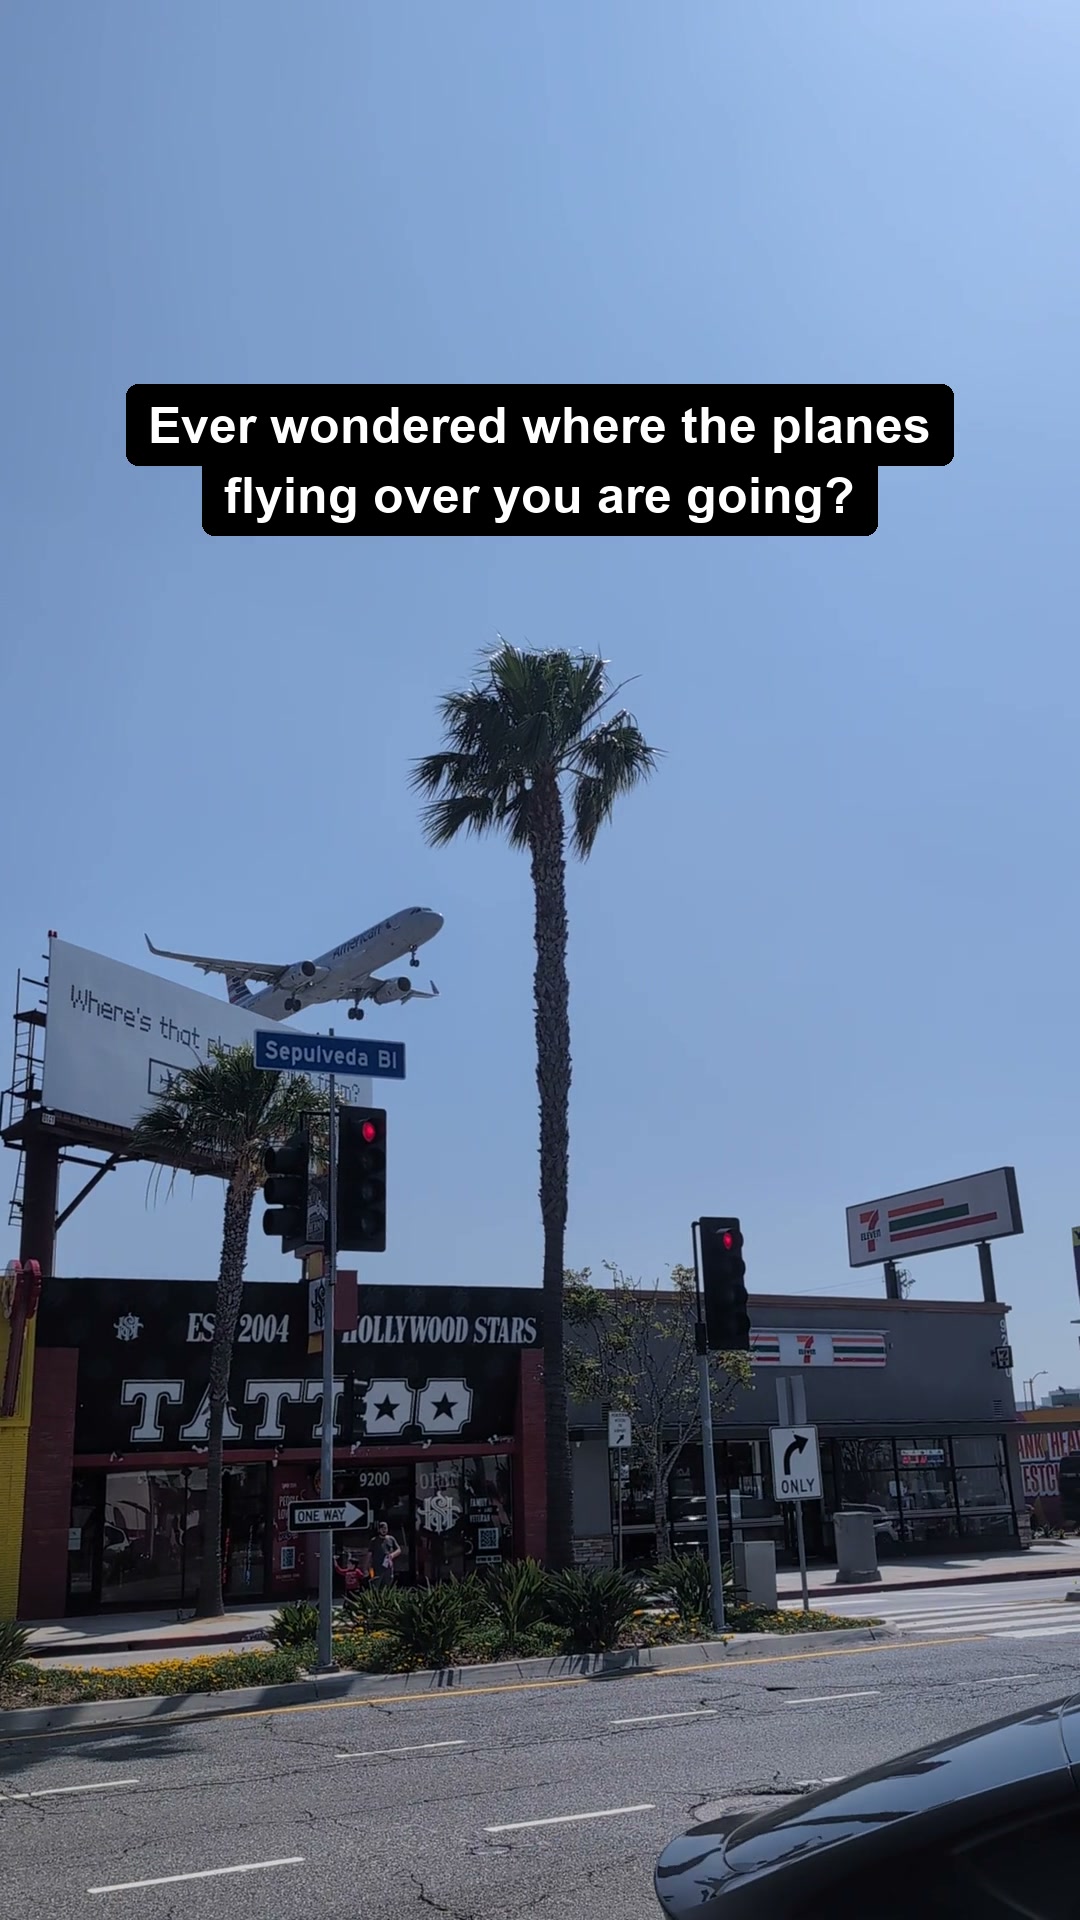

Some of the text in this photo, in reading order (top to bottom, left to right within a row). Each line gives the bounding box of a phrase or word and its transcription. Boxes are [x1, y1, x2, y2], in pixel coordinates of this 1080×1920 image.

[332, 925, 381, 960] American
[71, 985, 151, 1032] Where's
[160, 1016, 200, 1049] that
[265, 1040, 368, 1067] Sepulveda
[186, 1313, 289, 1342] ES 2004
[473, 1317, 537, 1343] STARS
[359, 1472, 391, 1487] 9200
[781, 1478, 815, 1496] ONLY
[298, 1508, 345, 1522] ONE WAY
